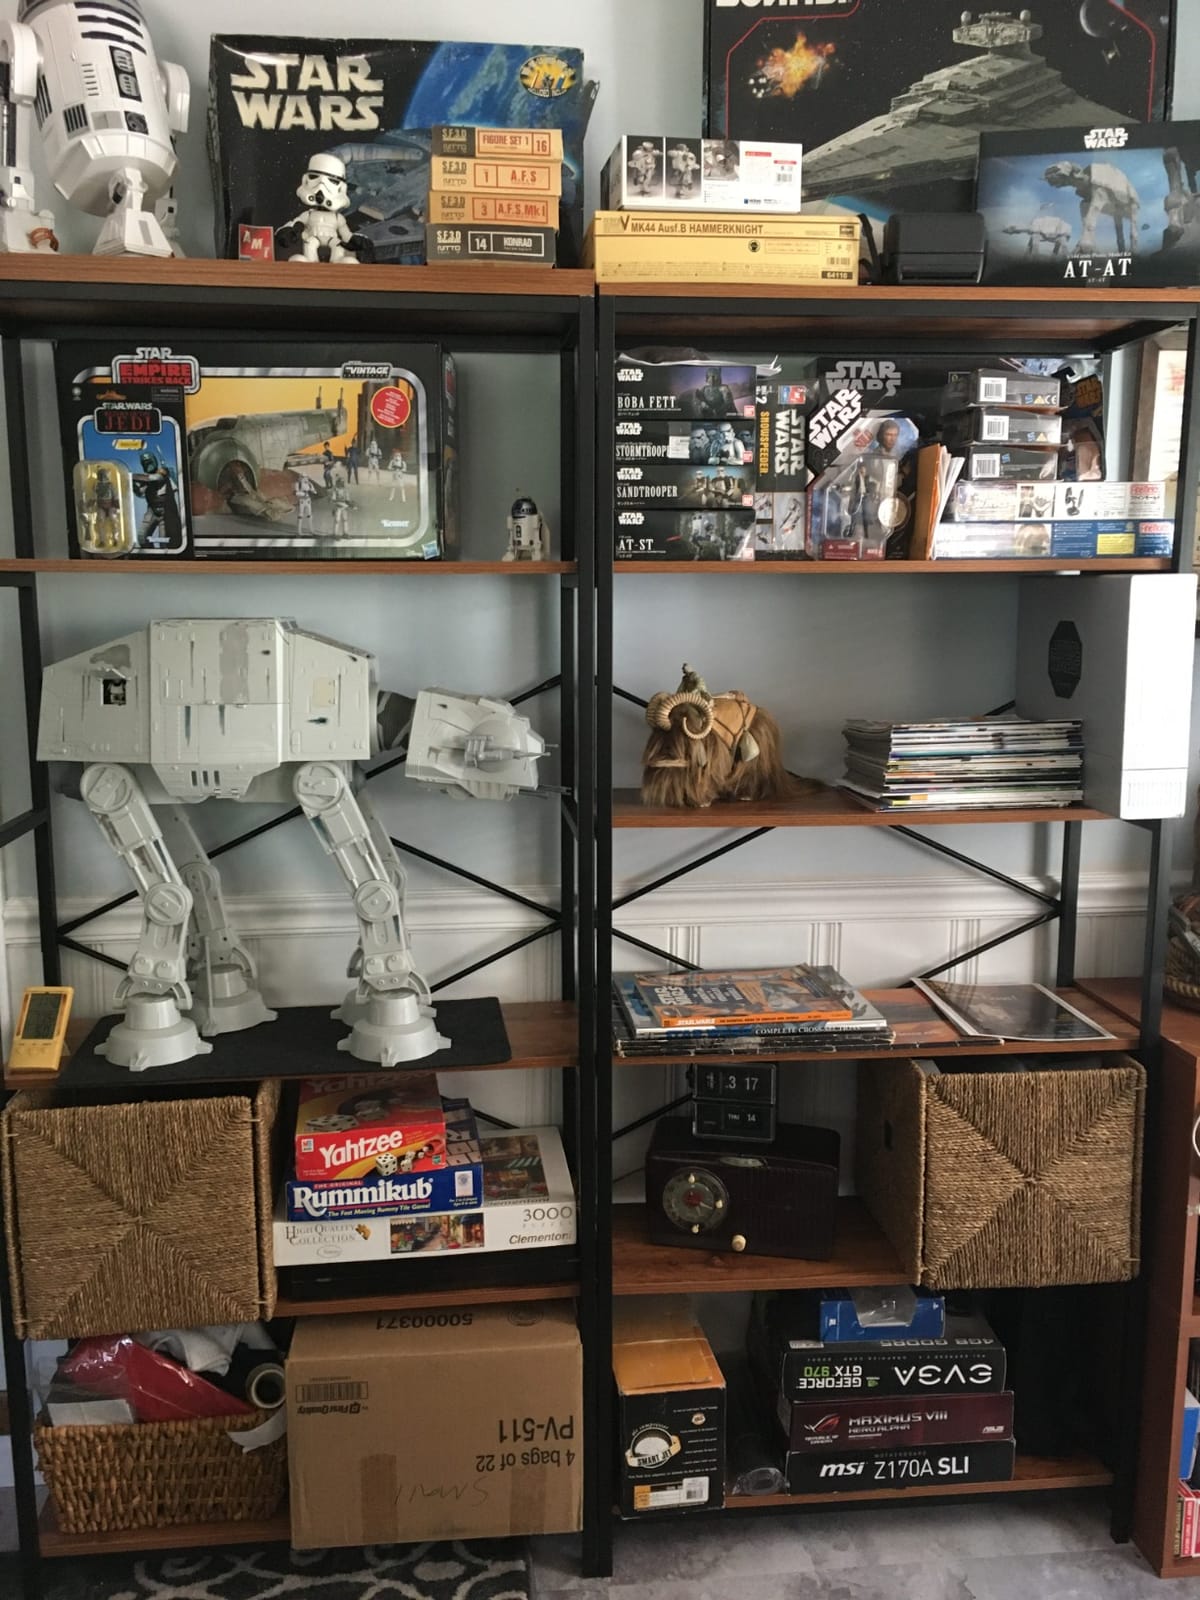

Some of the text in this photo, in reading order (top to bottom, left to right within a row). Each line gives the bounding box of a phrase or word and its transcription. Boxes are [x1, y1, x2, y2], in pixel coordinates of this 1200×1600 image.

[231, 54, 384, 91] STAR
[232, 91, 384, 131] WARS
[483, 135, 507, 145] FIGURE
[509, 136, 522, 145] SET
[1085, 128, 1128, 139] STAR
[536, 140, 547, 152] 16
[1084, 137, 1128, 148] WARS
[484, 172, 489, 183] 1
[481, 205, 488, 216] 3
[631, 223, 656, 233] MK44
[657, 223, 687, 234] Ausf.B
[688, 223, 764, 235] HAMMERKNIGHT
[475, 238, 487, 251] 14
[503, 236, 533, 248] KONRAD
[1064, 258, 1132, 278] AT-AT
[136, 347, 172, 359] STAR
[120, 363, 192, 376] EMPIRE
[350, 366, 389, 375] VINTAGE
[617, 368, 643, 376] STAR
[826, 361, 902, 379] STAR
[826, 379, 902, 400] WARS
[124, 402, 153, 410] WARS
[617, 396, 677, 409] BOBA FETT
[809, 389, 858, 441] STAR
[810, 394, 862, 449] WARS
[104, 413, 152, 431] JEDI
[616, 422, 642, 430] STAR
[760, 411, 769, 473] SNOWSPEEDER
[775, 409, 790, 475] WARS
[791, 409, 805, 475] STAR
[616, 445, 669, 457] STORMTROOP
[617, 467, 643, 475] STAR
[616, 485, 678, 498] SANDTROOPER
[618, 512, 644, 520] STAR
[618, 517, 644, 525] WARS
[619, 538, 654, 551] AT-ST
[755, 1027, 797, 1035] COMPLETE
[728, 1075, 737, 1089] 3
[744, 1077, 759, 1091] 17
[747, 1114, 756, 1122] 14
[319, 1130, 403, 1169] Yahtzee
[293, 1178, 432, 1217] Rummikub
[354, 1207, 376, 1216] Moving
[377, 1205, 399, 1214] Rummy
[400, 1203, 410, 1211] Tile
[523, 1206, 573, 1222] 3000
[509, 1233, 571, 1245] Clementoni
[376, 1313, 473, 1329] 5000371
[880, 1338, 994, 1347] 4GB GDDR5
[804, 1365, 862, 1377] GTX 970
[894, 1364, 992, 1385] EVGA
[798, 1377, 862, 1389] GEFORCE
[849, 1412, 922, 1426] MAXIMUS
[498, 1415, 575, 1443] PV-511
[982, 1425, 1005, 1434] ASUS
[475, 1448, 575, 1472] 4 bags of 22
[637, 1449, 673, 1466] SMART JET
[819, 1455, 970, 1480] msi Z170A SLI
